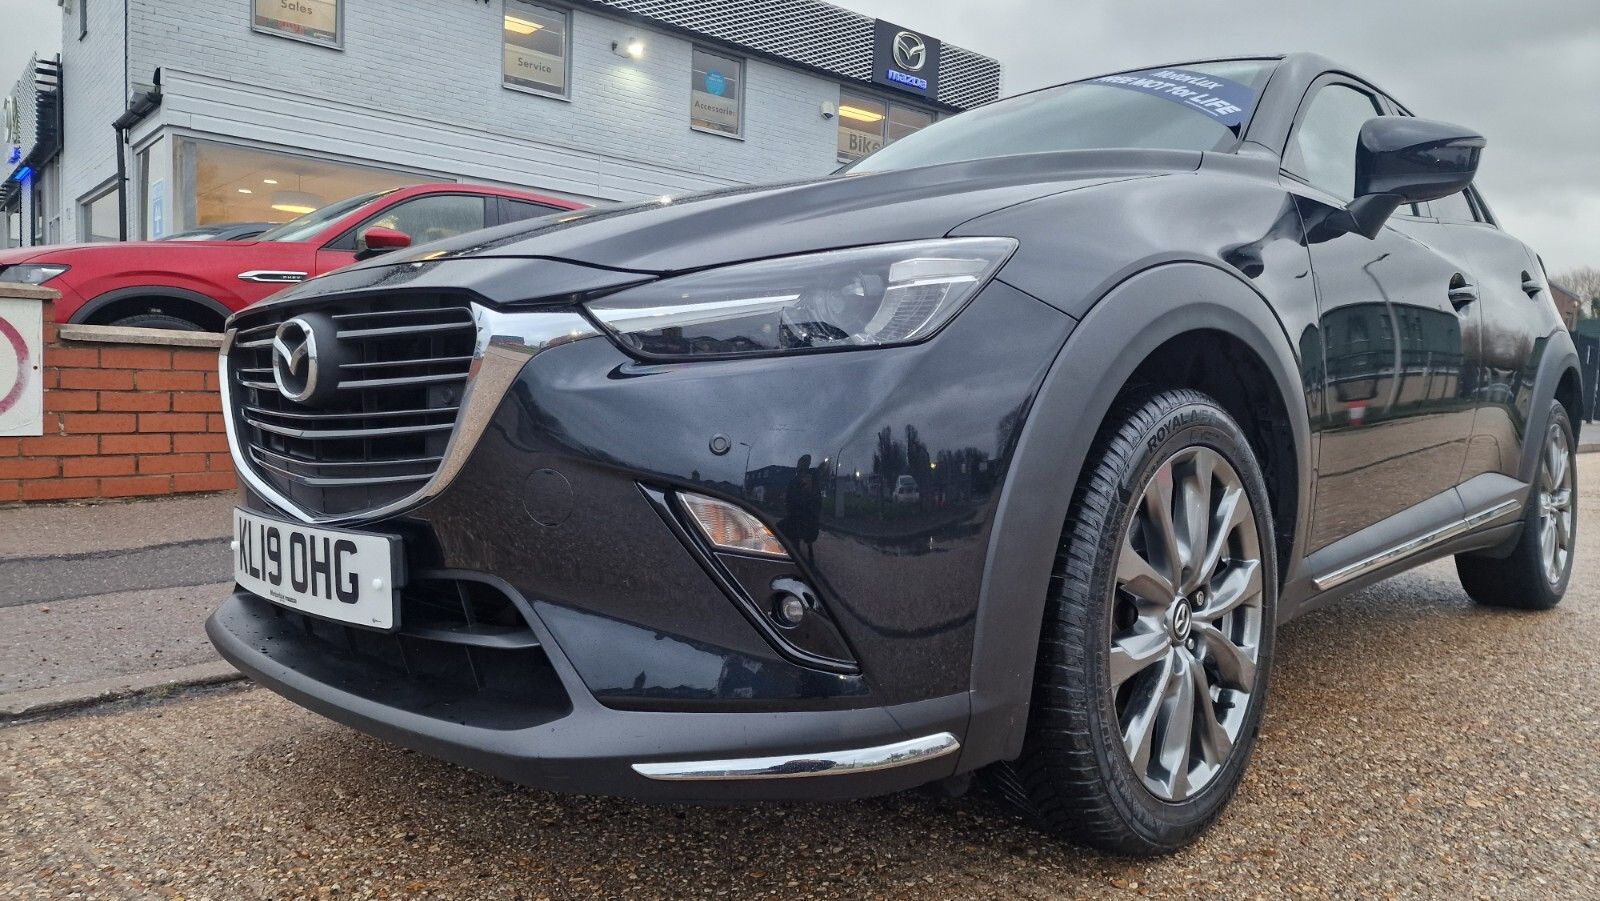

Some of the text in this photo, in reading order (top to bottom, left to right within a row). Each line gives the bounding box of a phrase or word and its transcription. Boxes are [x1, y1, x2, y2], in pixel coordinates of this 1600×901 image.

[281, 0, 313, 15] Sales
[518, 57, 552, 73] Service
[887, 69, 928, 89] mazda
[1128, 78, 1176, 90] MOT
[1164, 86, 1198, 98] for
[1190, 93, 1242, 116] LIFE
[239, 516, 360, 605] KL19 OHG
